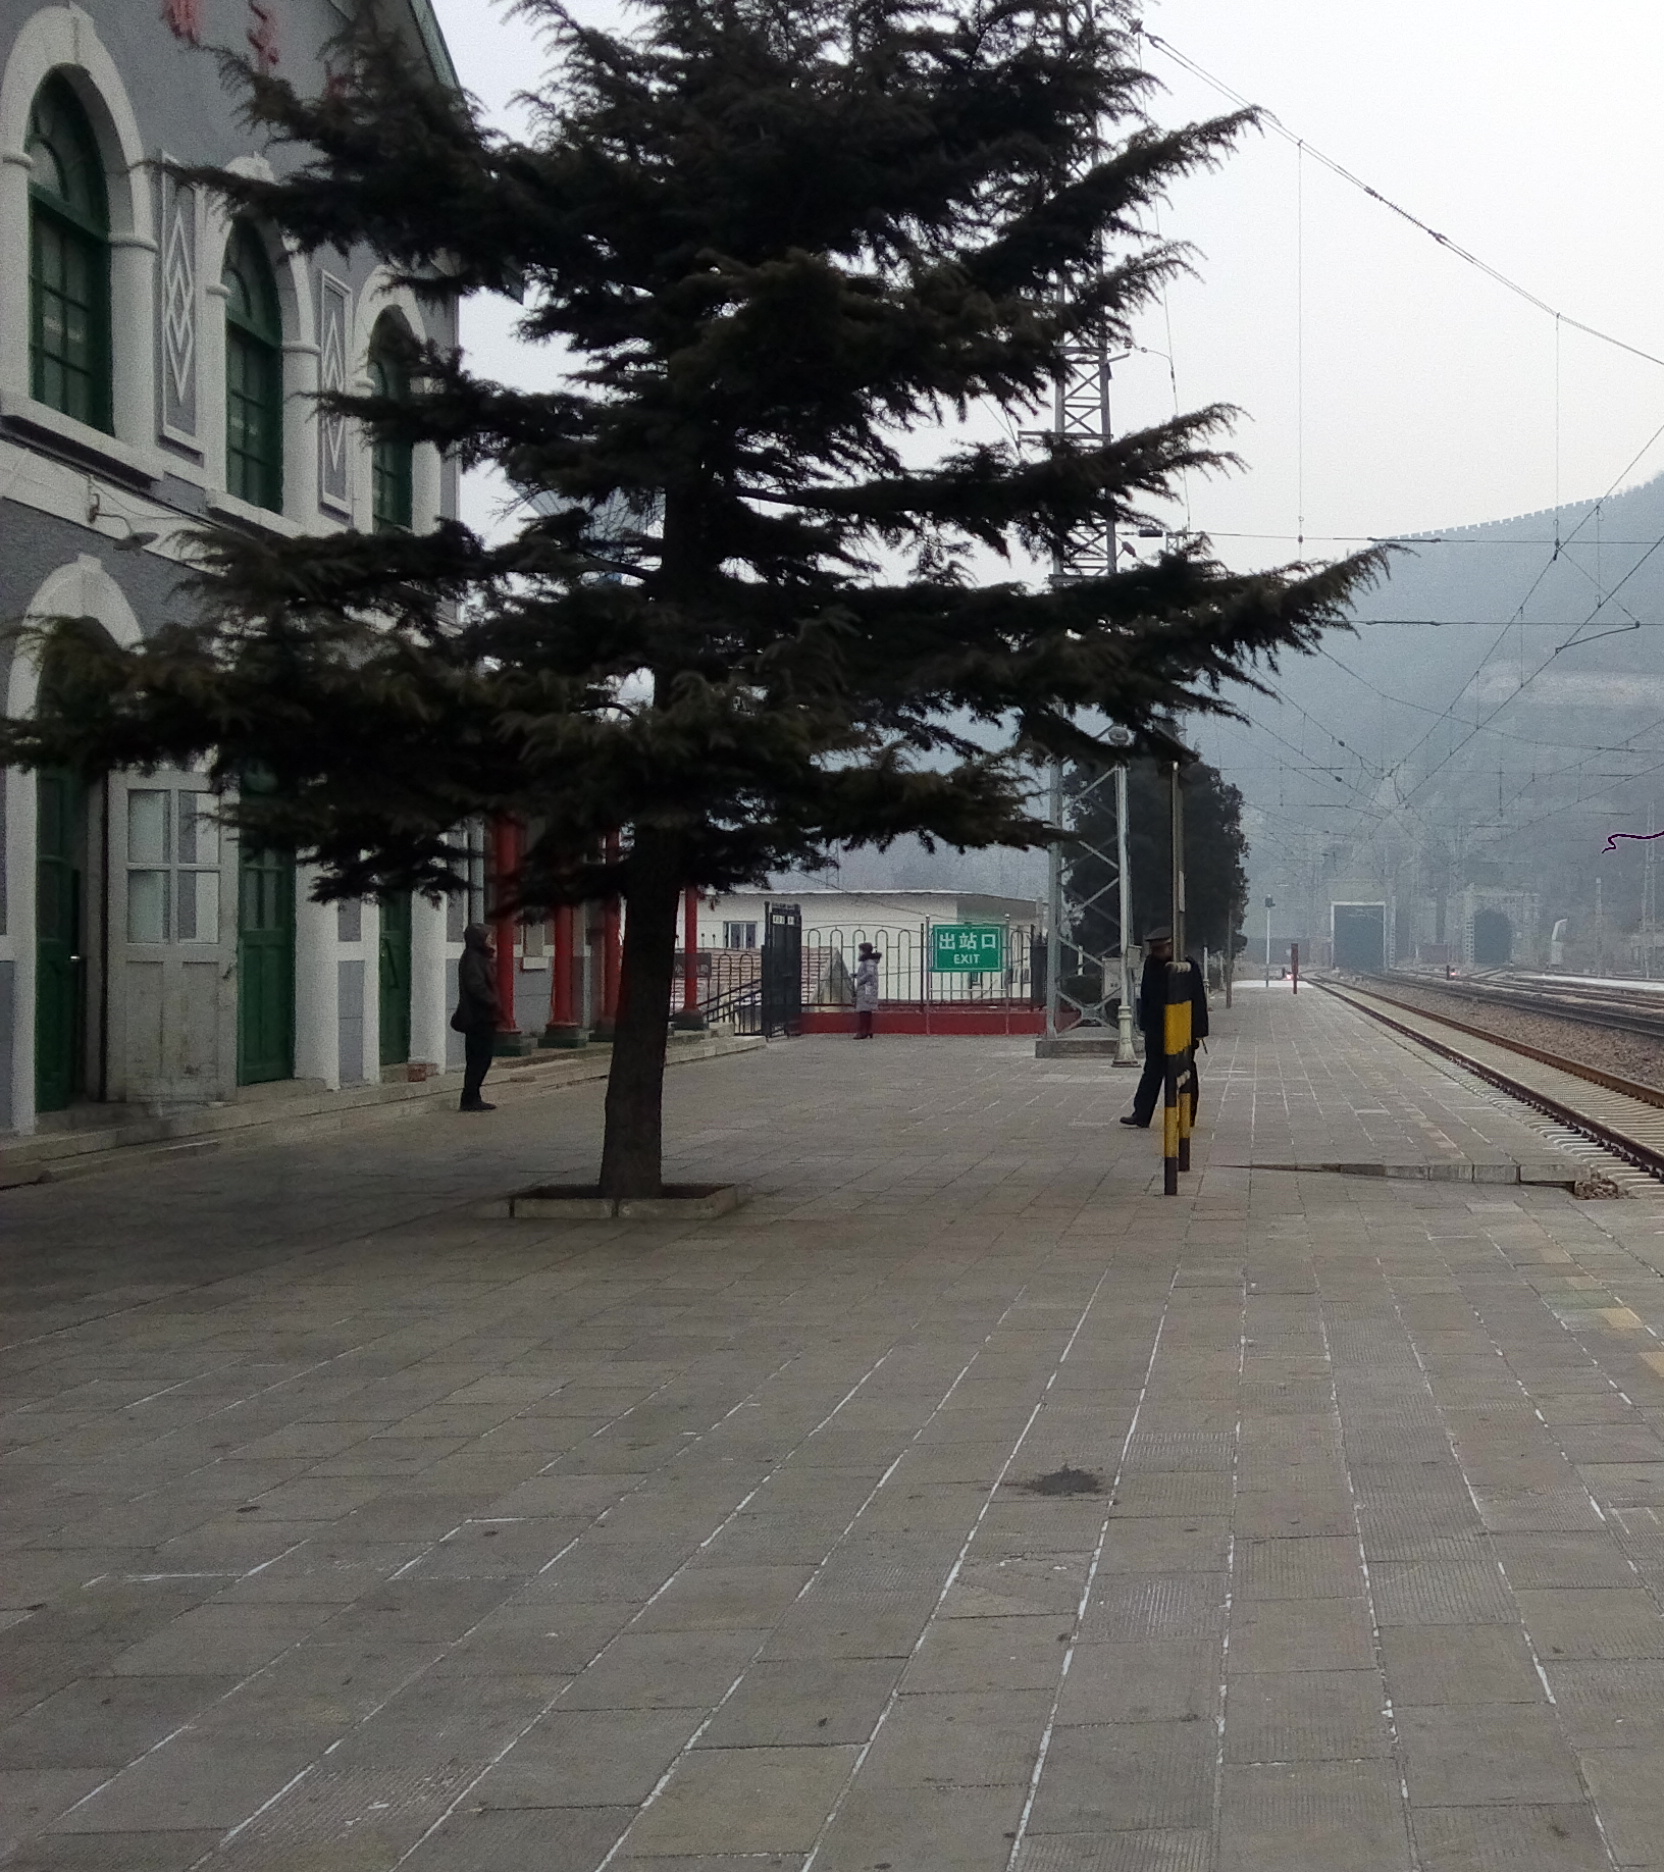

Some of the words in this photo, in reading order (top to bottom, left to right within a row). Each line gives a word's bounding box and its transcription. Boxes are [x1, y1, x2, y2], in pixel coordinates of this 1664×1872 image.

[939, 932, 996, 950] 出站口
[953, 953, 981, 965] EXIT
